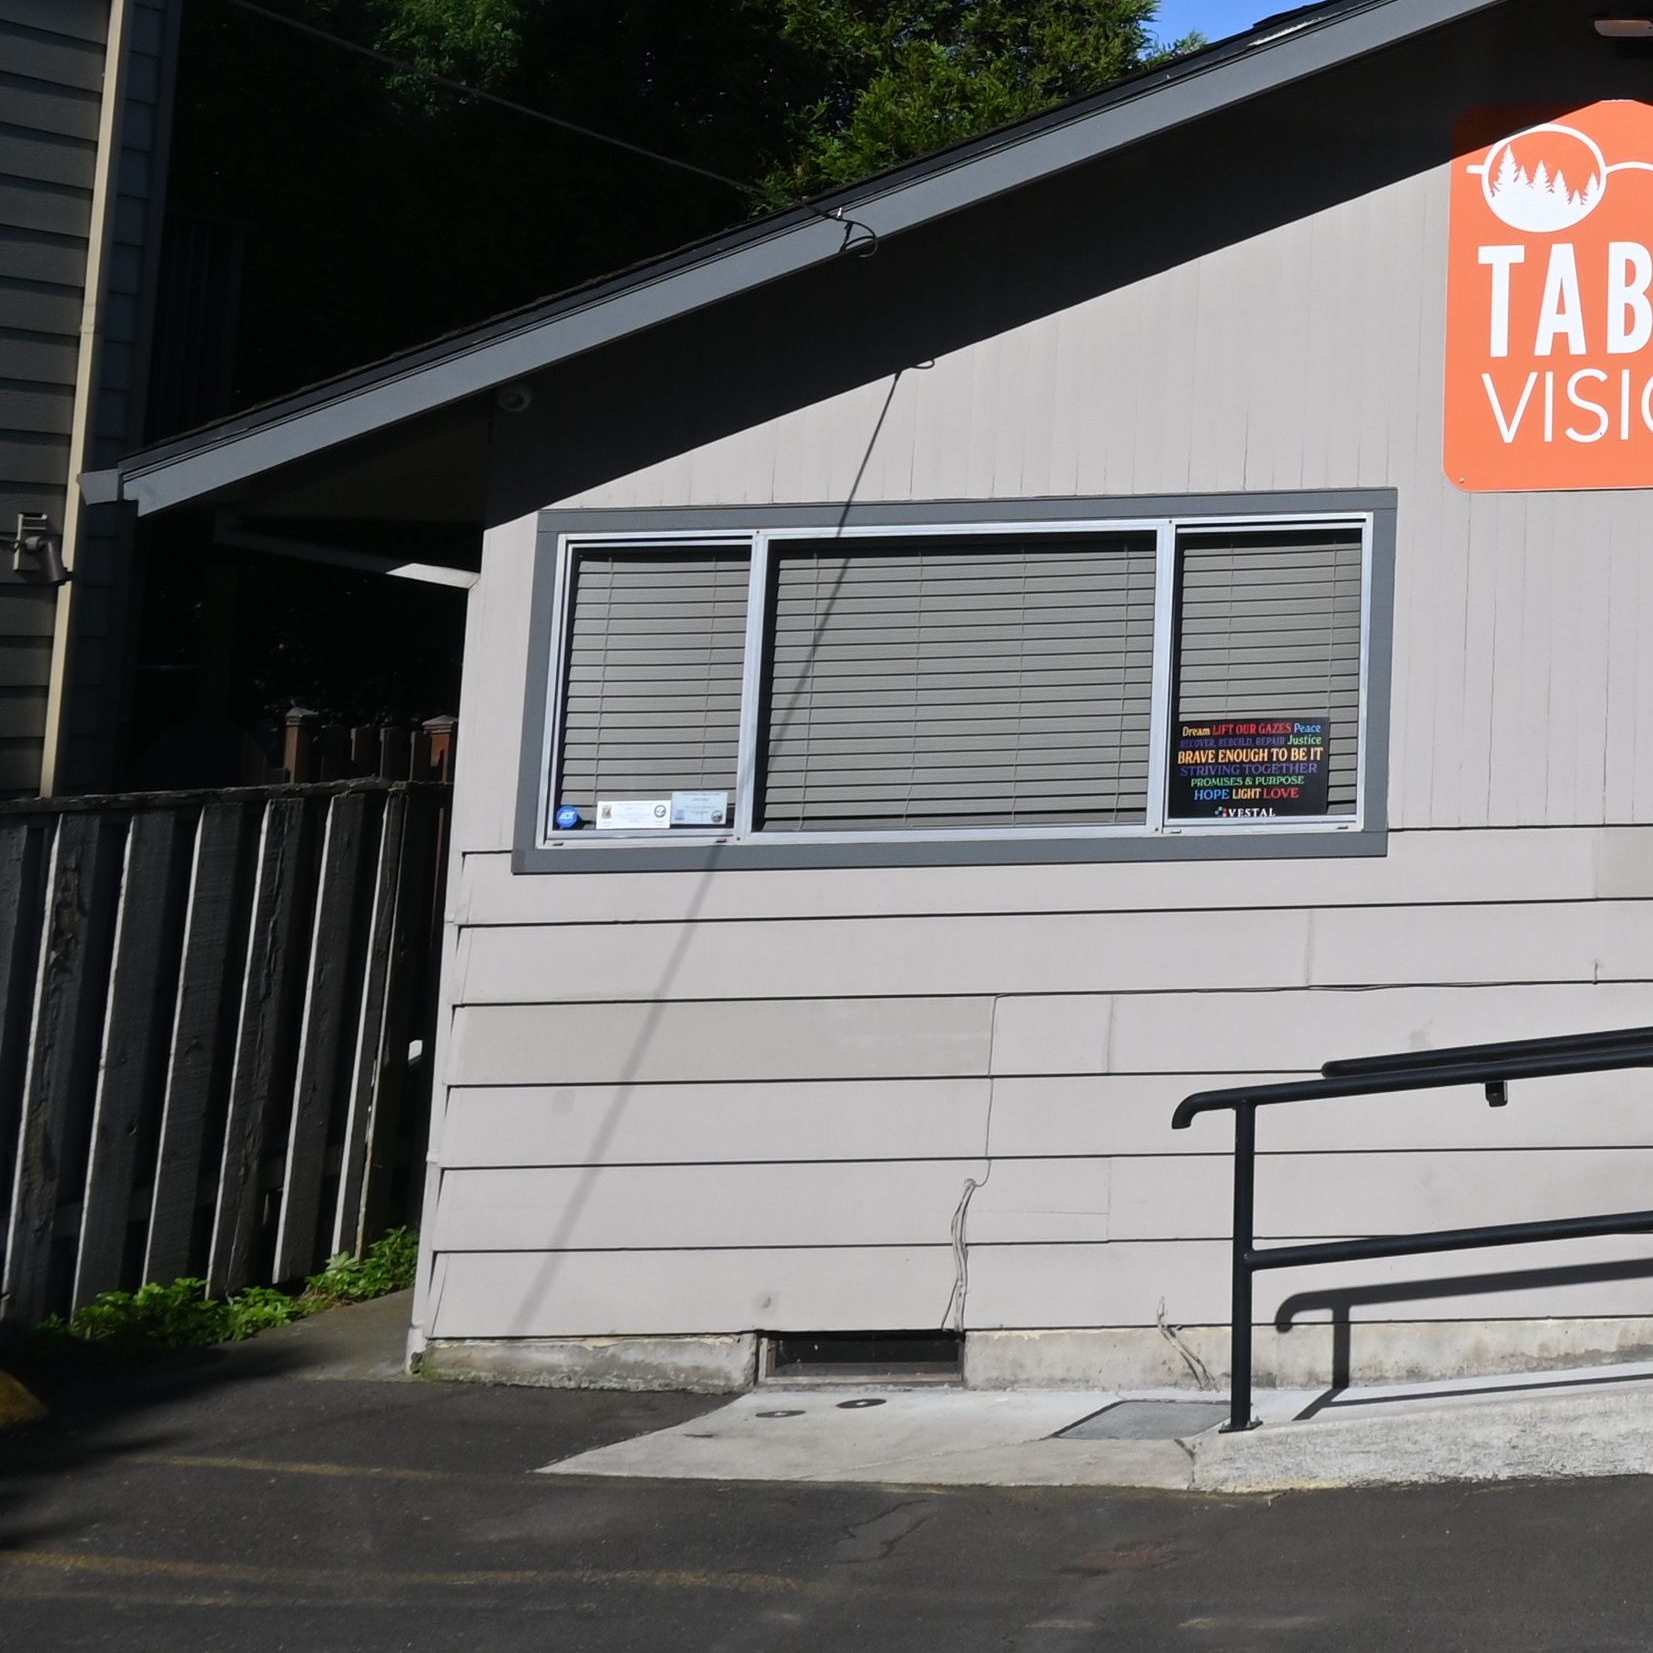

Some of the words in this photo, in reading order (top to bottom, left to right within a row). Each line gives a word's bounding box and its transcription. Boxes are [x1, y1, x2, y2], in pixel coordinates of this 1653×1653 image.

[1182, 726, 1211, 737] Dream
[1212, 724, 1234, 735] LIFT
[1235, 723, 1257, 735] OUR
[1258, 722, 1292, 734] GAZES
[1294, 722, 1322, 733] Peace
[1287, 734, 1322, 745] Justice
[1177, 749, 1216, 764] BRAVE
[1218, 748, 1268, 763] ENOUGH
[1270, 747, 1288, 762] TO
[1290, 747, 1308, 761] BE
[1310, 746, 1324, 761] IT
[1180, 764, 1240, 777] STRIVING
[1243, 763, 1318, 775] TOGETHER
[1190, 776, 1243, 787] PROMISES
[1245, 776, 1253, 785] &
[1255, 775, 1305, 786] PURPOSE
[1194, 788, 1230, 801] HOPE
[1232, 788, 1261, 800] LIGHT
[1263, 787, 1299, 799] LOVE
[1228, 807, 1276, 818] VESTAL
